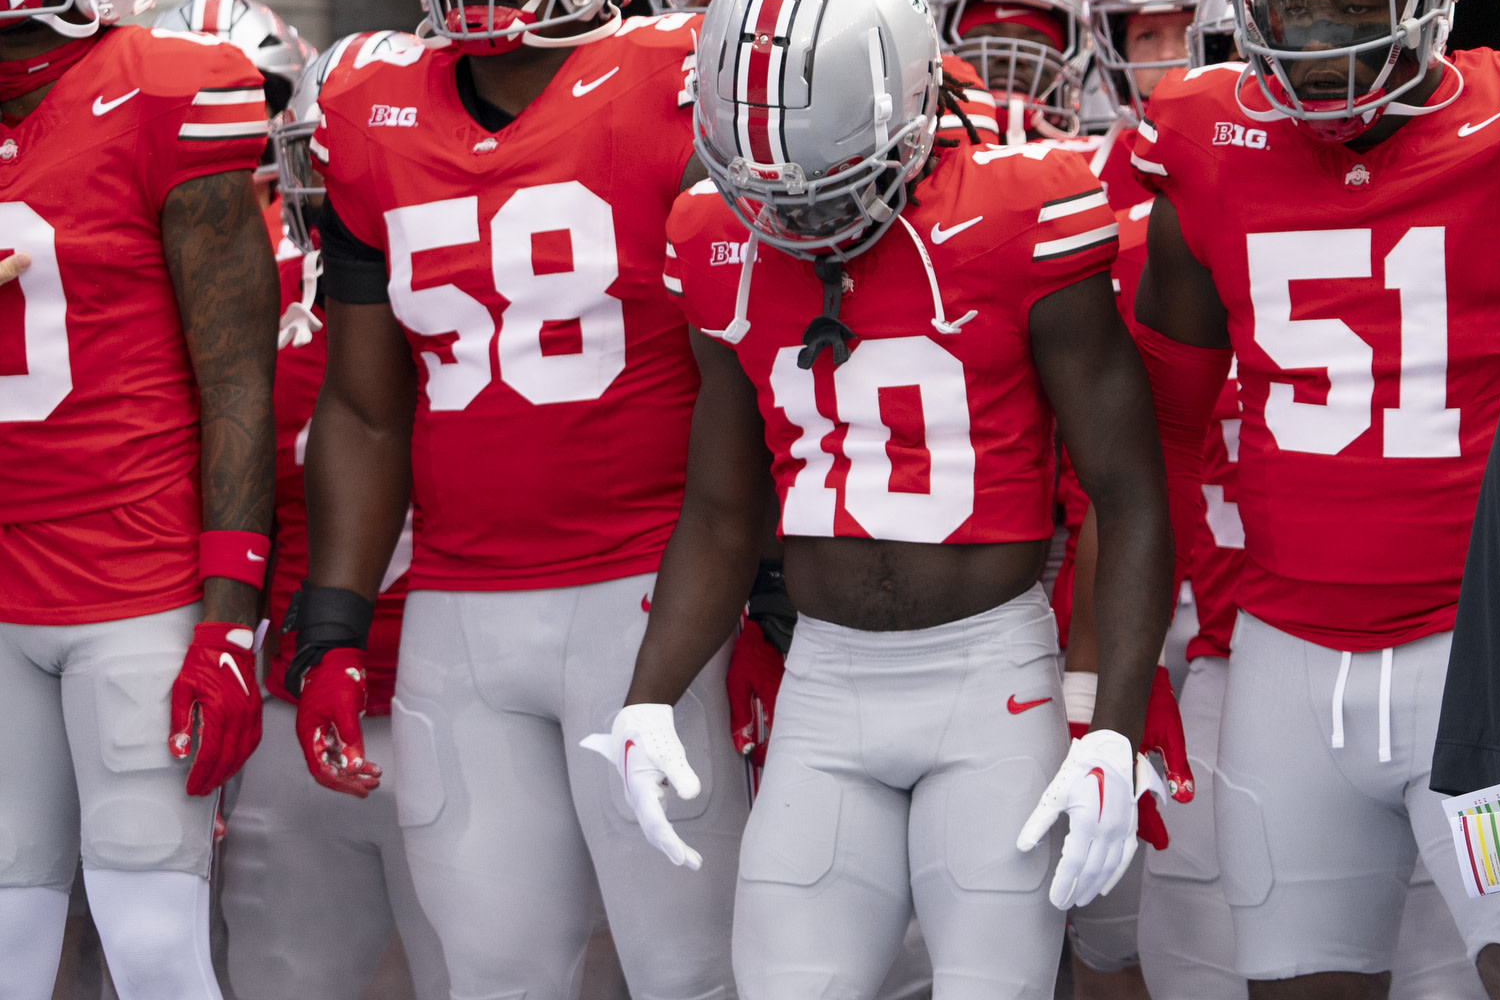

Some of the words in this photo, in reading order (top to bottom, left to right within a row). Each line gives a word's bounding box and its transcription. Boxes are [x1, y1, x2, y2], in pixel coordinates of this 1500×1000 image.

[1212, 121, 1267, 149] B1G
[384, 180, 626, 412] 58
[1246, 226, 1462, 458] 51
[769, 336, 976, 544] 10
